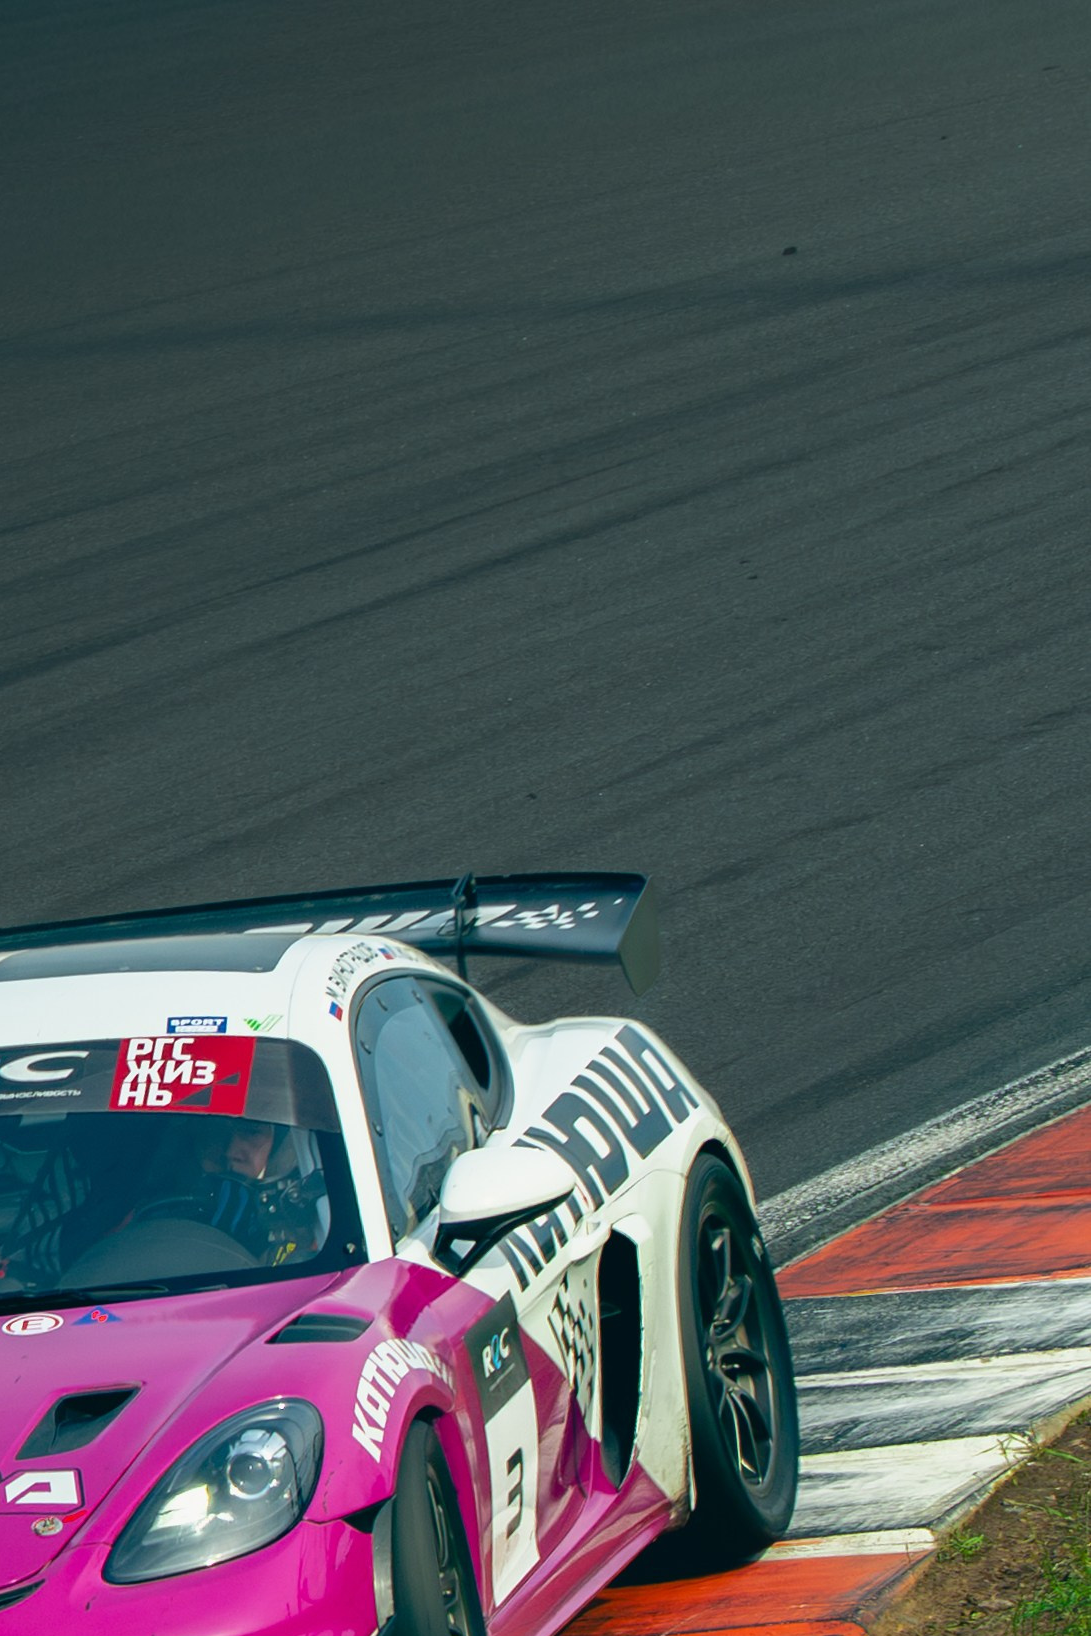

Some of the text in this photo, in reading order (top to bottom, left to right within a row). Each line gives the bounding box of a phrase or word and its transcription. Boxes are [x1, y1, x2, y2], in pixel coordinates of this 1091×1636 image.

[126, 1037, 195, 1061] РГС
[122, 1060, 217, 1085] ЖИЗ
[117, 1082, 173, 1107] НЬ
[506, 1447, 524, 1541] 3
